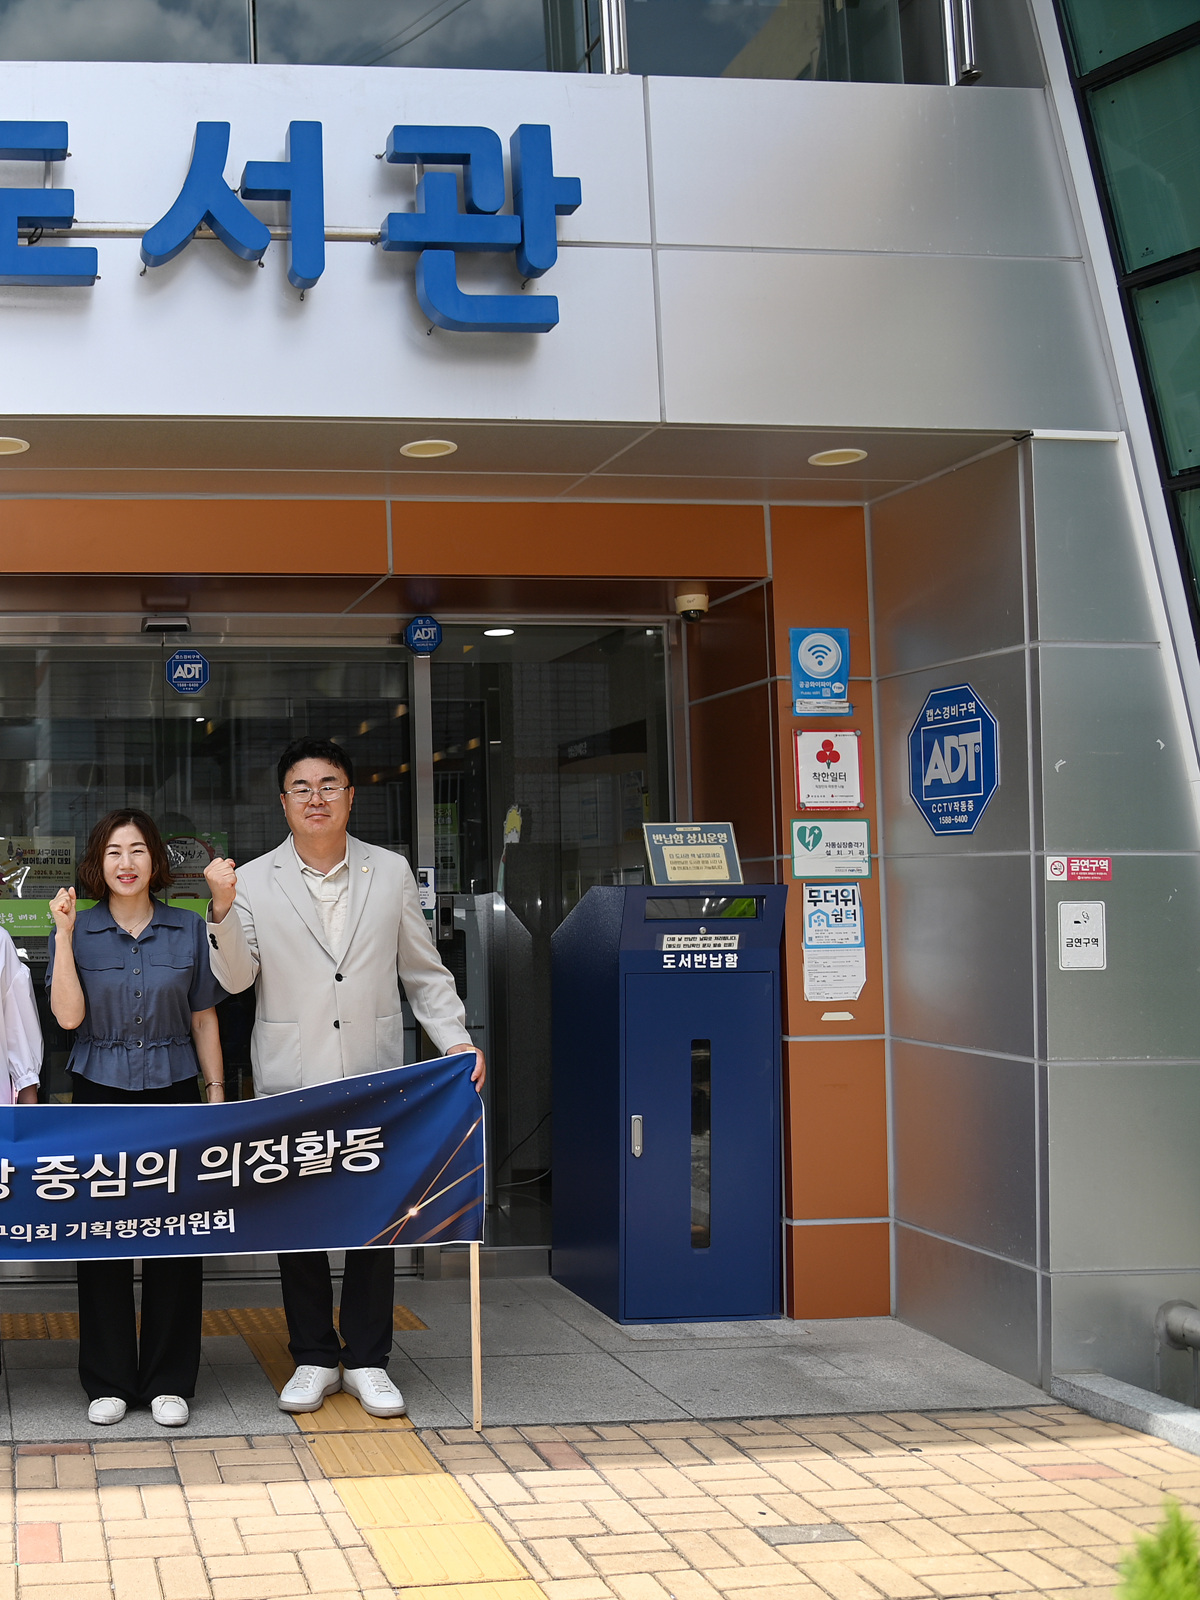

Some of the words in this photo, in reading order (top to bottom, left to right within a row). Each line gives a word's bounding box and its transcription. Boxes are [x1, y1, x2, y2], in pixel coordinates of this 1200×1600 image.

[413, 628, 436, 640] ADT
[173, 664, 202, 678] ADT
[926, 702, 976, 722] 캡스경비구역
[924, 731, 981, 786] ADT
[812, 772, 847, 782] 착한일터
[932, 800, 974, 814] CCTV작동중
[938, 814, 968, 824] 1588-6400
[652, 833, 684, 844] 반납함
[686, 832, 728, 844] 상시운영
[37, 848, 71, 857] 서구어린이
[58, 857, 71, 865] 대회
[1070, 860, 1109, 872] 금연구역
[807, 888, 856, 907] 무더위
[831, 908, 856, 923] 쉼터
[1066, 938, 1099, 948] 금연구역
[662, 952, 738, 968] 도서반납함
[31, 1149, 177, 1201] 중심의
[197, 1126, 384, 1187] 의정활동
[65, 1208, 236, 1240] 기획행정위원회
